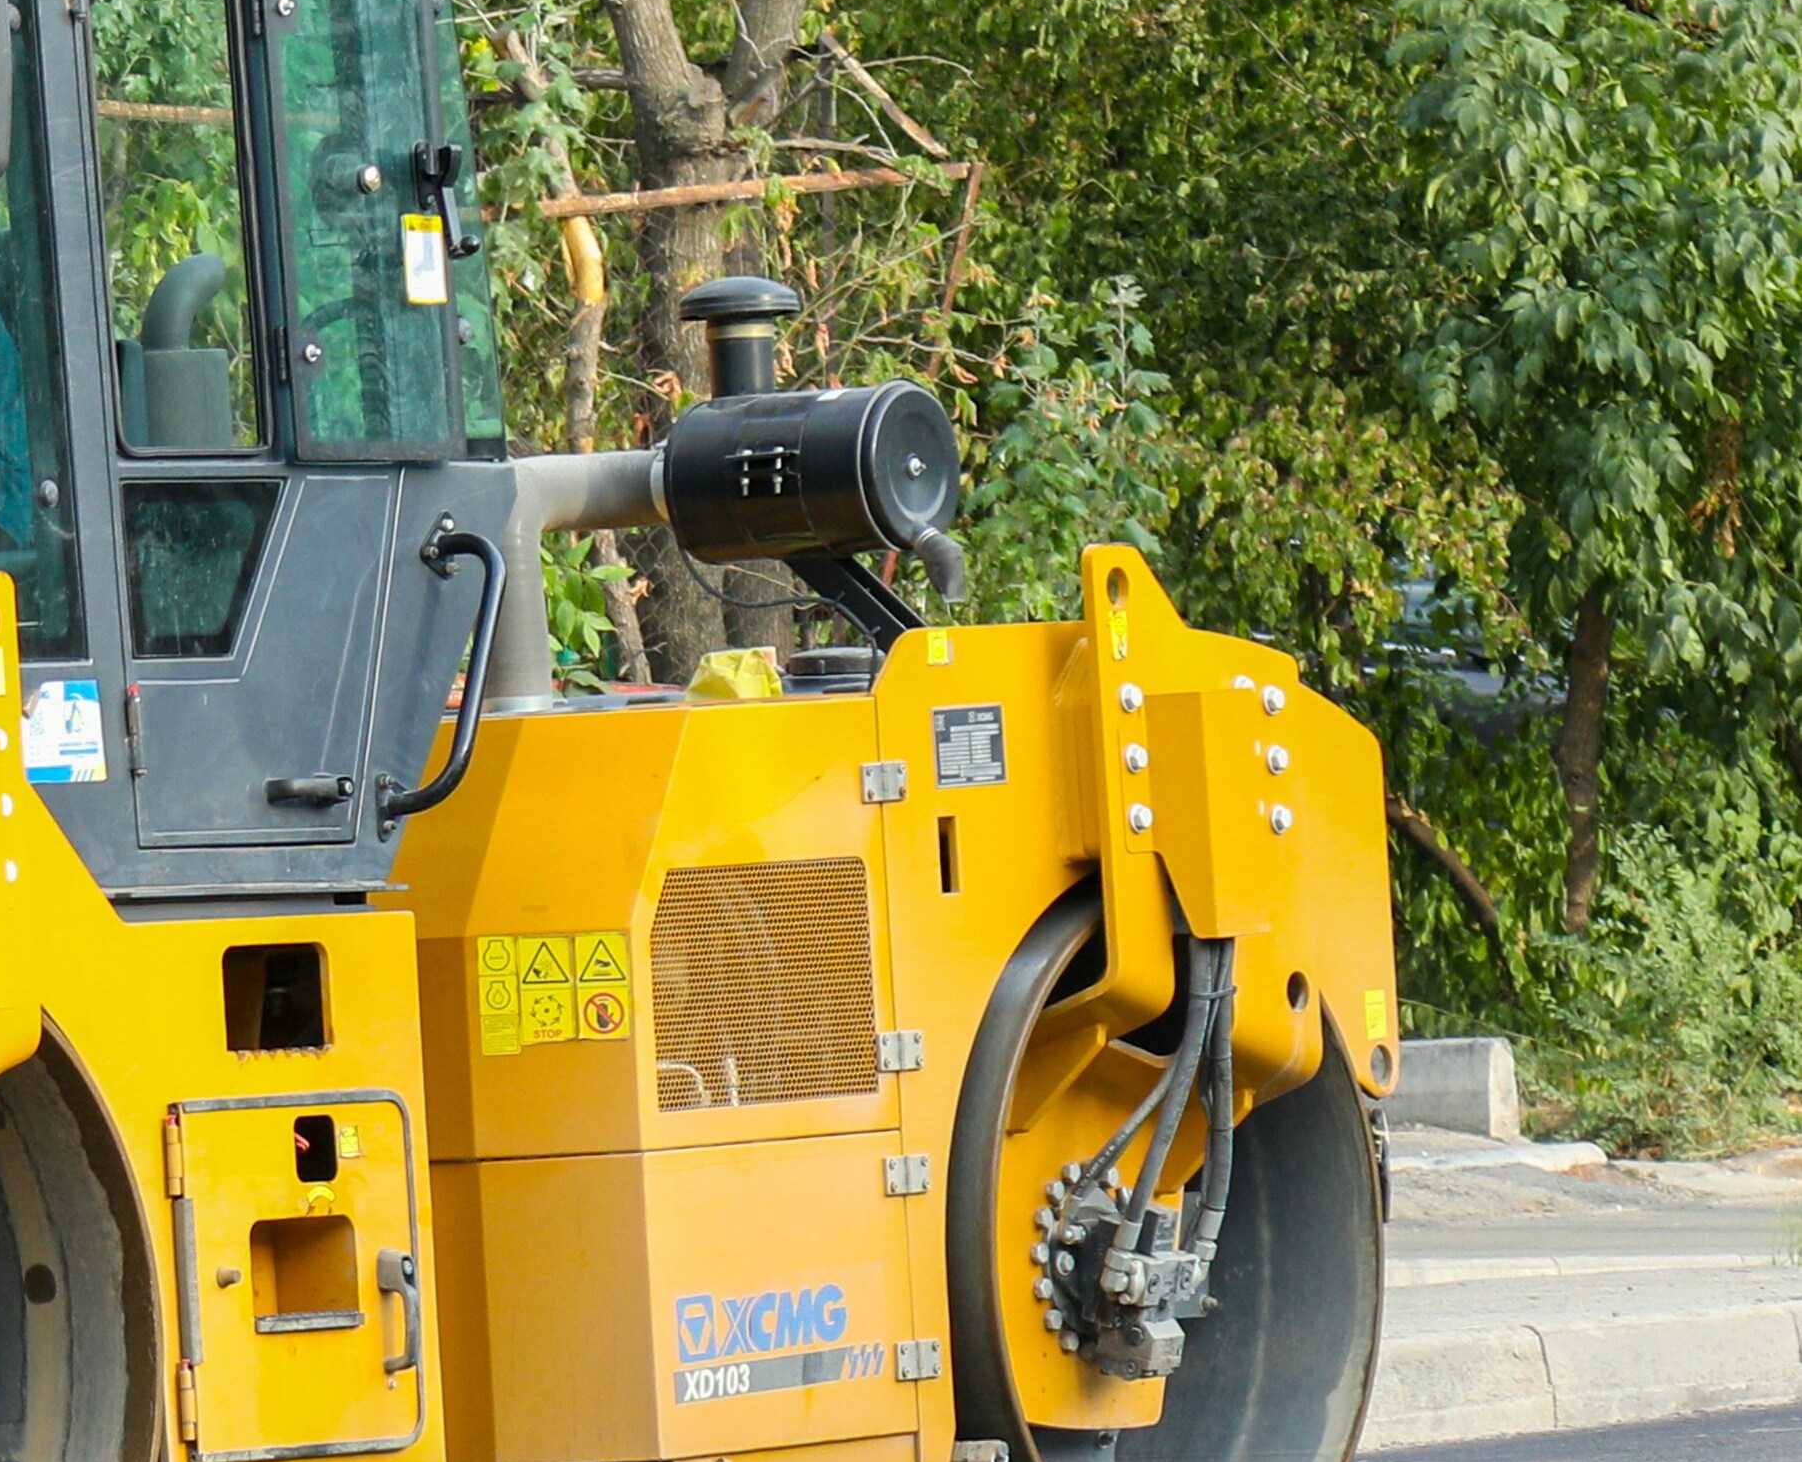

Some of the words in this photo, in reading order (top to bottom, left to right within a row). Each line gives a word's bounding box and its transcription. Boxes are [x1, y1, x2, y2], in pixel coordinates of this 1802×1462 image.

[533, 1028, 563, 1039] STOP
[718, 1284, 847, 1357] XCMG
[683, 1363, 750, 1401] XD103
